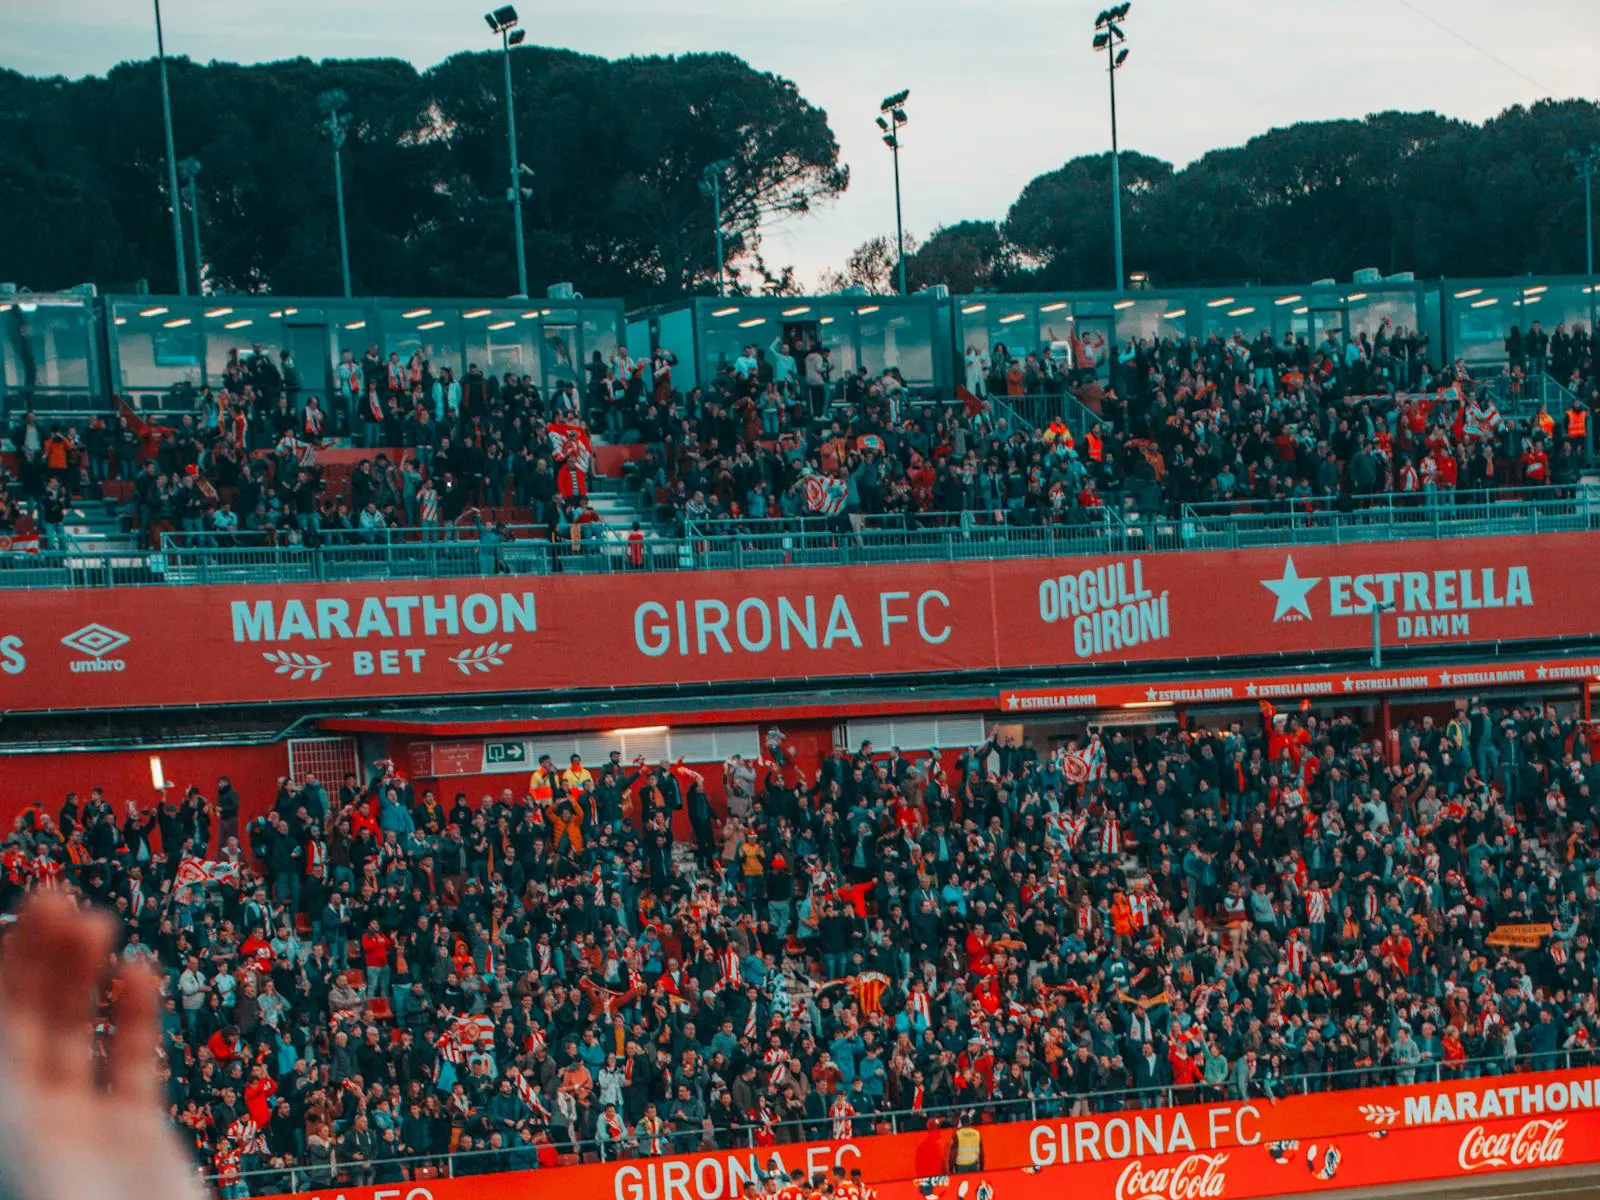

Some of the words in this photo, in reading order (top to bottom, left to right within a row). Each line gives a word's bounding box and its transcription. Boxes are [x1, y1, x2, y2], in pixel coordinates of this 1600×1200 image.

[1039, 558, 1152, 623] ORGULL
[1328, 565, 1534, 617] ESTRELLA
[230, 591, 537, 642] MARATHON
[634, 594, 863, 657] GIRONA
[879, 589, 952, 646] FC
[1397, 613, 1470, 639] DAMM
[70, 657, 126, 673] umbro
[353, 648, 426, 676] BET
[1549, 665, 1591, 678] ESTRELLA
[1259, 683, 1302, 696] ESTRELLA
[1303, 682, 1332, 694] DAMM
[1355, 678, 1399, 690] ESTRELLA
[1400, 676, 1428, 688] DAMM
[1453, 672, 1496, 684] ESTRELLA
[1497, 669, 1525, 682] DAMM
[1021, 696, 1066, 708] ESTRELLA
[1067, 694, 1097, 705] DAMM
[1158, 688, 1203, 700] ESTRELLA
[1204, 687, 1233, 699] DAMM
[1029, 1111, 1196, 1166] GIRONA
[1208, 1105, 1261, 1149] FC
[1457, 1118, 1569, 1171] Coca-Cola
